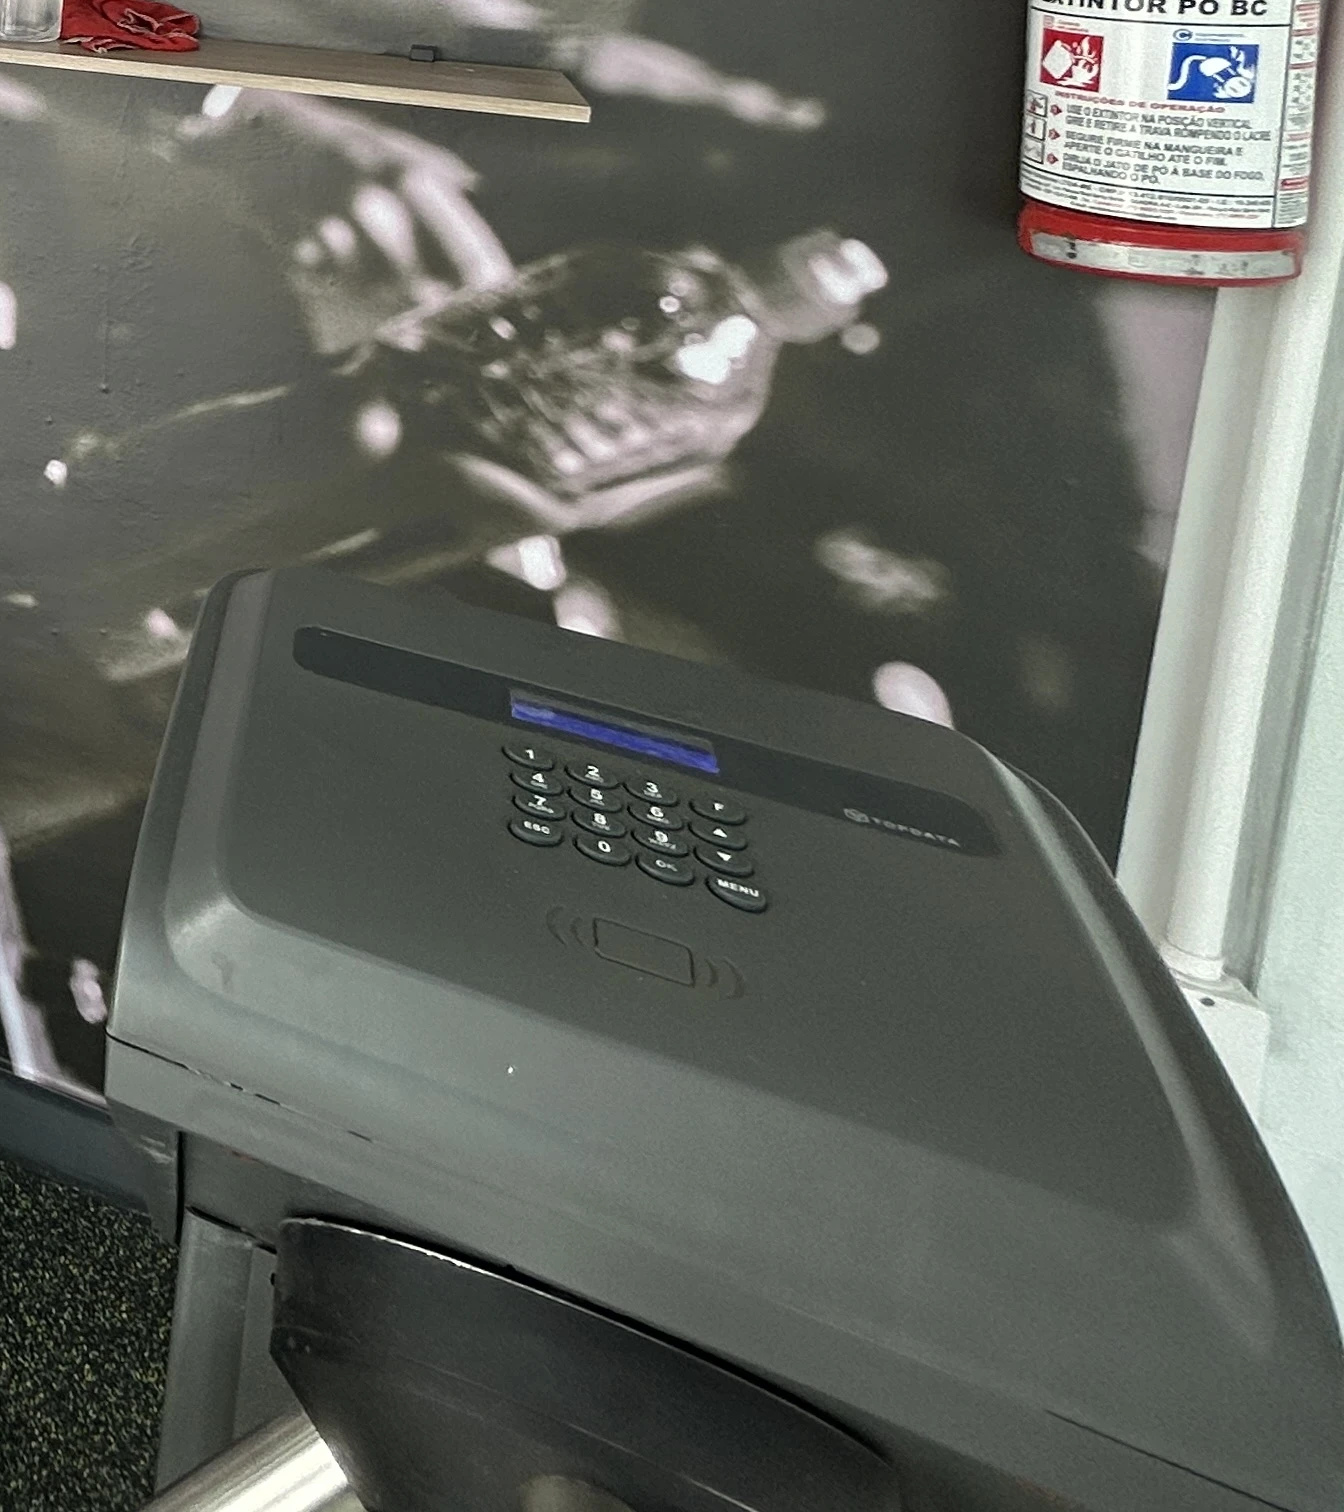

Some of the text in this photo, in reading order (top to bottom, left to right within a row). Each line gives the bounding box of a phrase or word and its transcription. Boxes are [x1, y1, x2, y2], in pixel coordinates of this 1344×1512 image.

[1230, 0, 1268, 16] BC
[1150, 103, 1225, 113] OPERAÇÃO
[1158, 114, 1204, 128] POSIÇÃO
[1144, 141, 1161, 150] NA
[1164, 143, 1233, 156] MANGUEIRA
[1104, 147, 1113, 156] O
[1194, 156, 1203, 165] O
[1130, 173, 1139, 181] O
[525, 749, 535, 759] 1
[587, 765, 600, 777] 2
[532, 773, 544, 783] 4
[646, 782, 659, 793] 3
[534, 794, 547, 806] 7
[590, 788, 603, 800] 5
[650, 806, 664, 818] 6
[594, 813, 607, 825] 8
[523, 820, 550, 835] ESC
[871, 816, 962, 847] TOPDATA
[654, 830, 668, 843] 9
[598, 840, 611, 853] 0
[655, 859, 678, 871] OK
[716, 878, 759, 897] MENU
